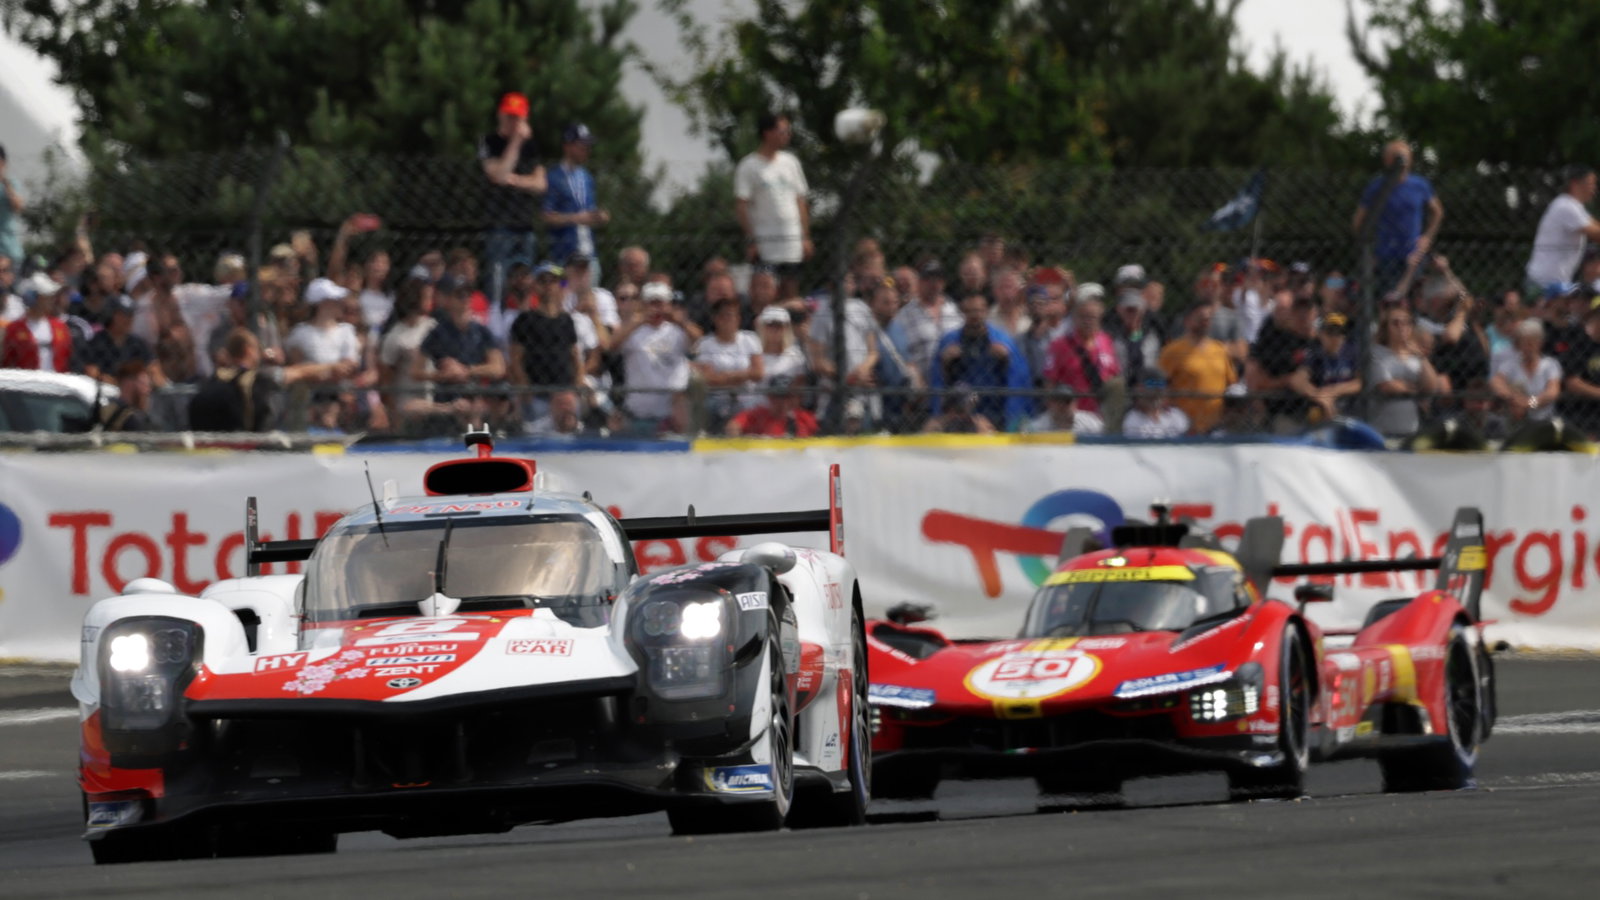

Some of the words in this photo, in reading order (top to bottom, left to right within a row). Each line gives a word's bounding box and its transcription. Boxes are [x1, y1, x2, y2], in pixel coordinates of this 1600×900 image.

[369, 643, 458, 656] FUJITSU
[511, 645, 566, 654] CAR
[257, 654, 304, 671] HY
[994, 658, 1073, 679] 50
[374, 664, 440, 677] ZENT
